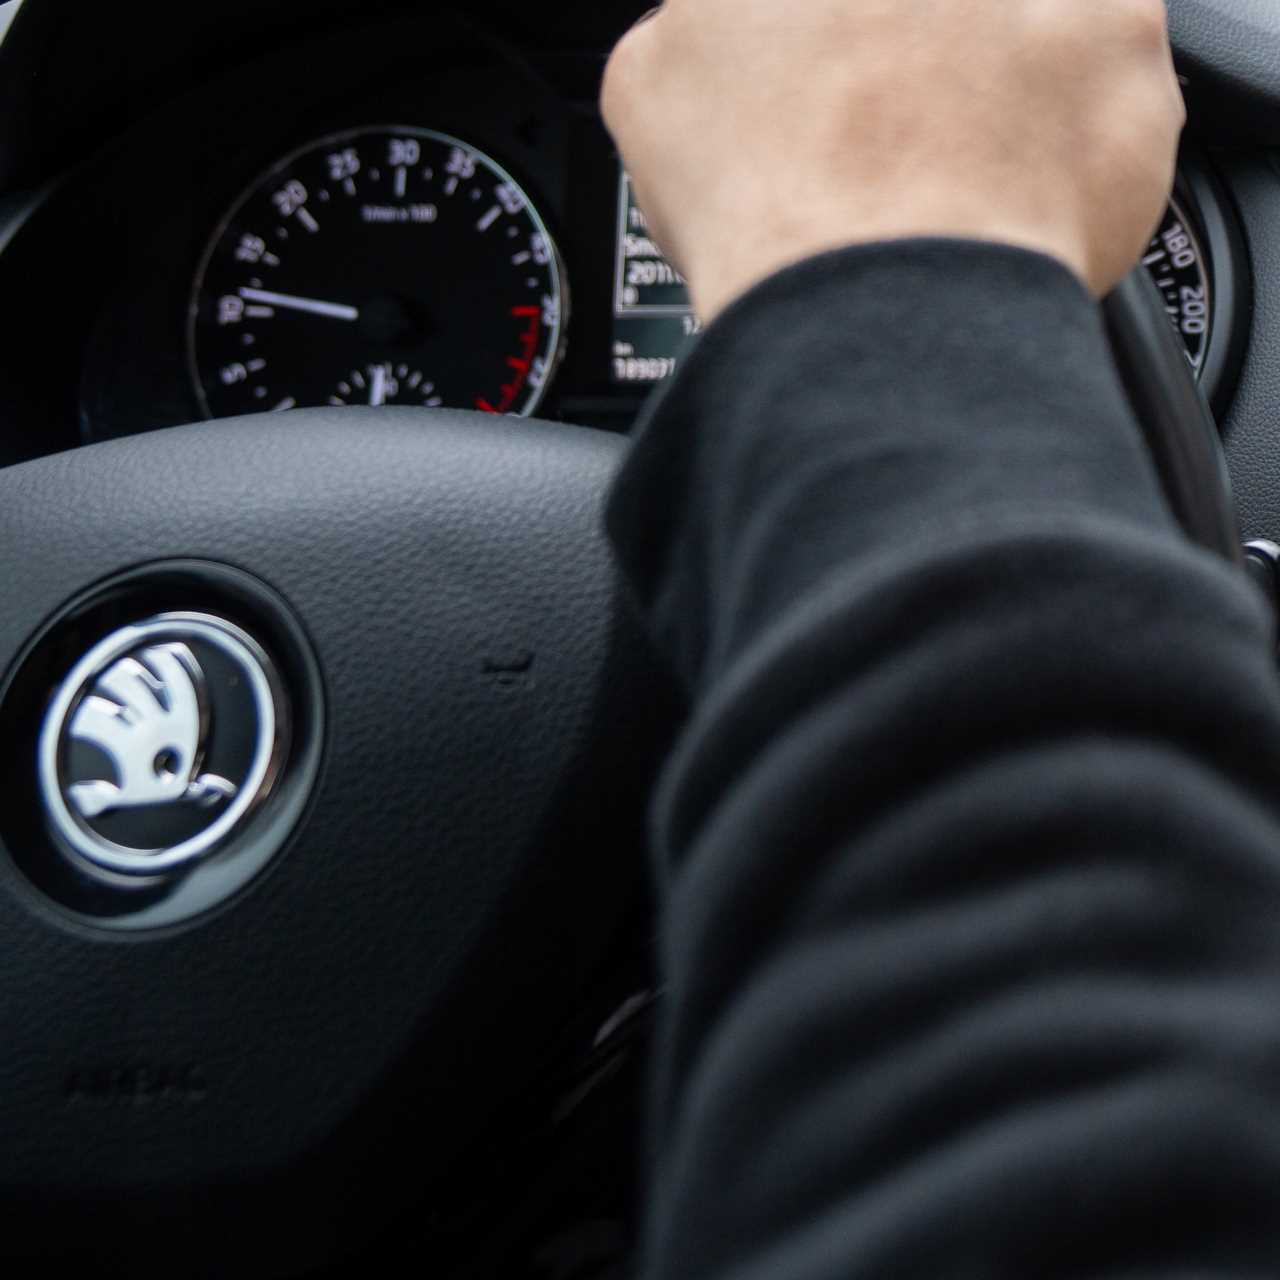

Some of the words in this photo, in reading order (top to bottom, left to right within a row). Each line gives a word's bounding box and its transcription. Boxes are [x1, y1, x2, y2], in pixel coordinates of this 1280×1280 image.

[389, 138, 420, 166] 30
[1164, 224, 1194, 268] 180
[1180, 286, 1205, 333] 200
